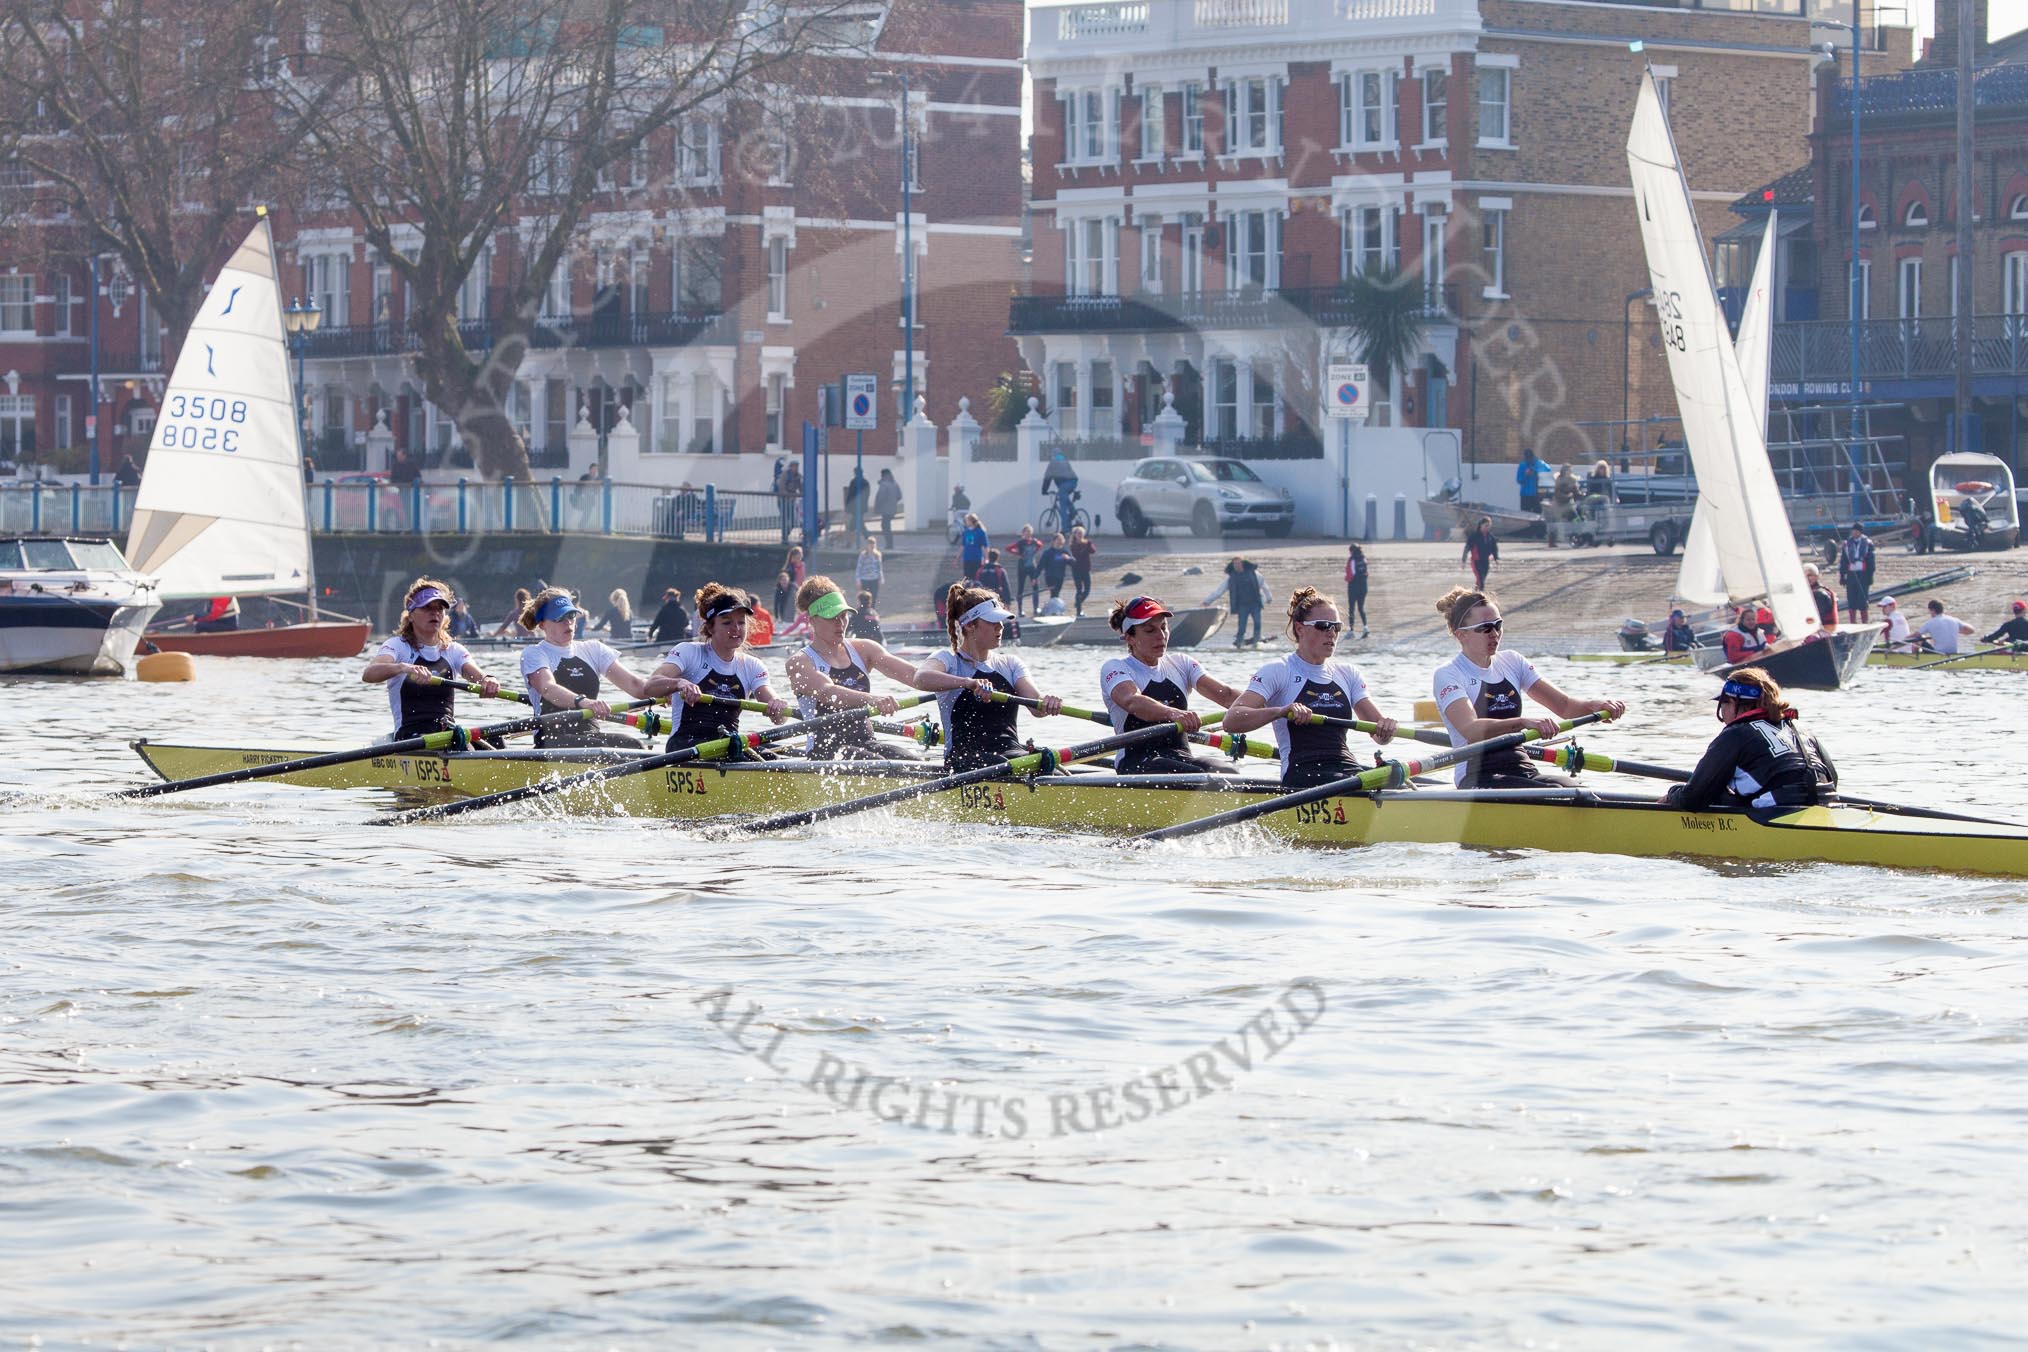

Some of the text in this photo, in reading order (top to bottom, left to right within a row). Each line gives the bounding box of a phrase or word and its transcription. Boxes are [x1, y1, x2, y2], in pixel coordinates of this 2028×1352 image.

[1769, 383, 1799, 395] ONDON
[1804, 382, 1838, 394] ROWING
[171, 396, 247, 423] 3508
[242, 754, 260, 764] HARRY
[386, 758, 397, 769] 001
[414, 760, 440, 781] ISPS
[665, 771, 694, 794] ISPS
[960, 786, 991, 808] ISPS
[1296, 798, 1331, 824] ISPS
[1681, 816, 1737, 832] Molesey B.C.
